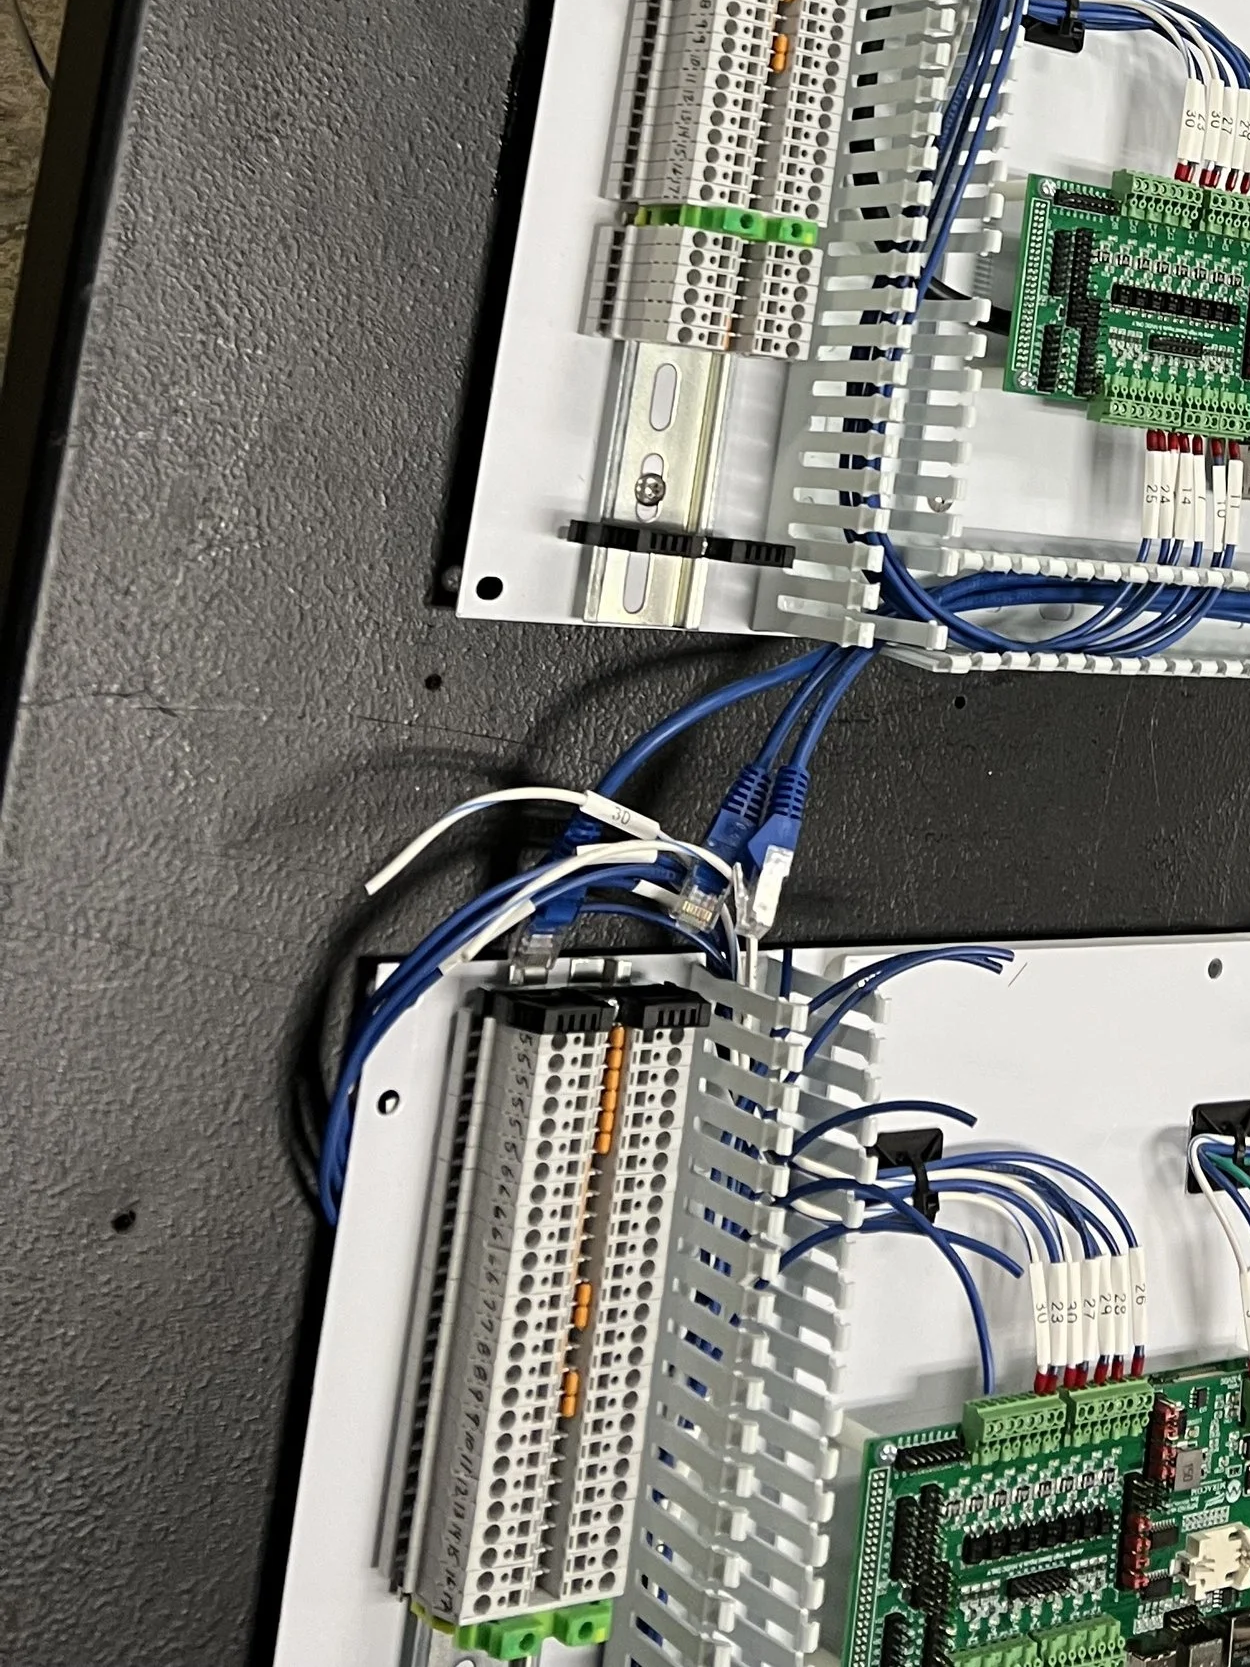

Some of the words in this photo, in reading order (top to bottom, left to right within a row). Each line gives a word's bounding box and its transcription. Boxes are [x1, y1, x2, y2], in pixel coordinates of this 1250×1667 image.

[700, 0, 711, 9] 8
[690, 54, 701, 67] 10
[685, 74, 697, 83] 11
[682, 90, 695, 103] 12
[680, 109, 692, 122] 13
[1185, 109, 1196, 128] 30
[1211, 110, 1221, 129] 30
[678, 126, 690, 138] 14
[1221, 117, 1234, 135] 27
[674, 144, 688, 159] 15
[1146, 484, 1158, 503] 25
[1160, 484, 1171, 504] 24
[1181, 488, 1192, 505] 14
[1230, 495, 1241, 509] 11
[1217, 502, 1226, 519] 10
[612, 806, 631, 825] 30
[1100, 1293, 1112, 1315] 29
[1135, 1283, 1146, 1306] 26
[1036, 1303, 1048, 1324] 30
[1051, 1301, 1064, 1324] 23
[1067, 1301, 1078, 1324] 30
[1083, 1298, 1096, 1320] 27
[1114, 1293, 1127, 1316] 28
[465, 1431, 475, 1452] 10
[460, 1454, 472, 1474] 11
[1183, 1463, 1193, 1483] 150
[455, 1477, 468, 1496] 12
